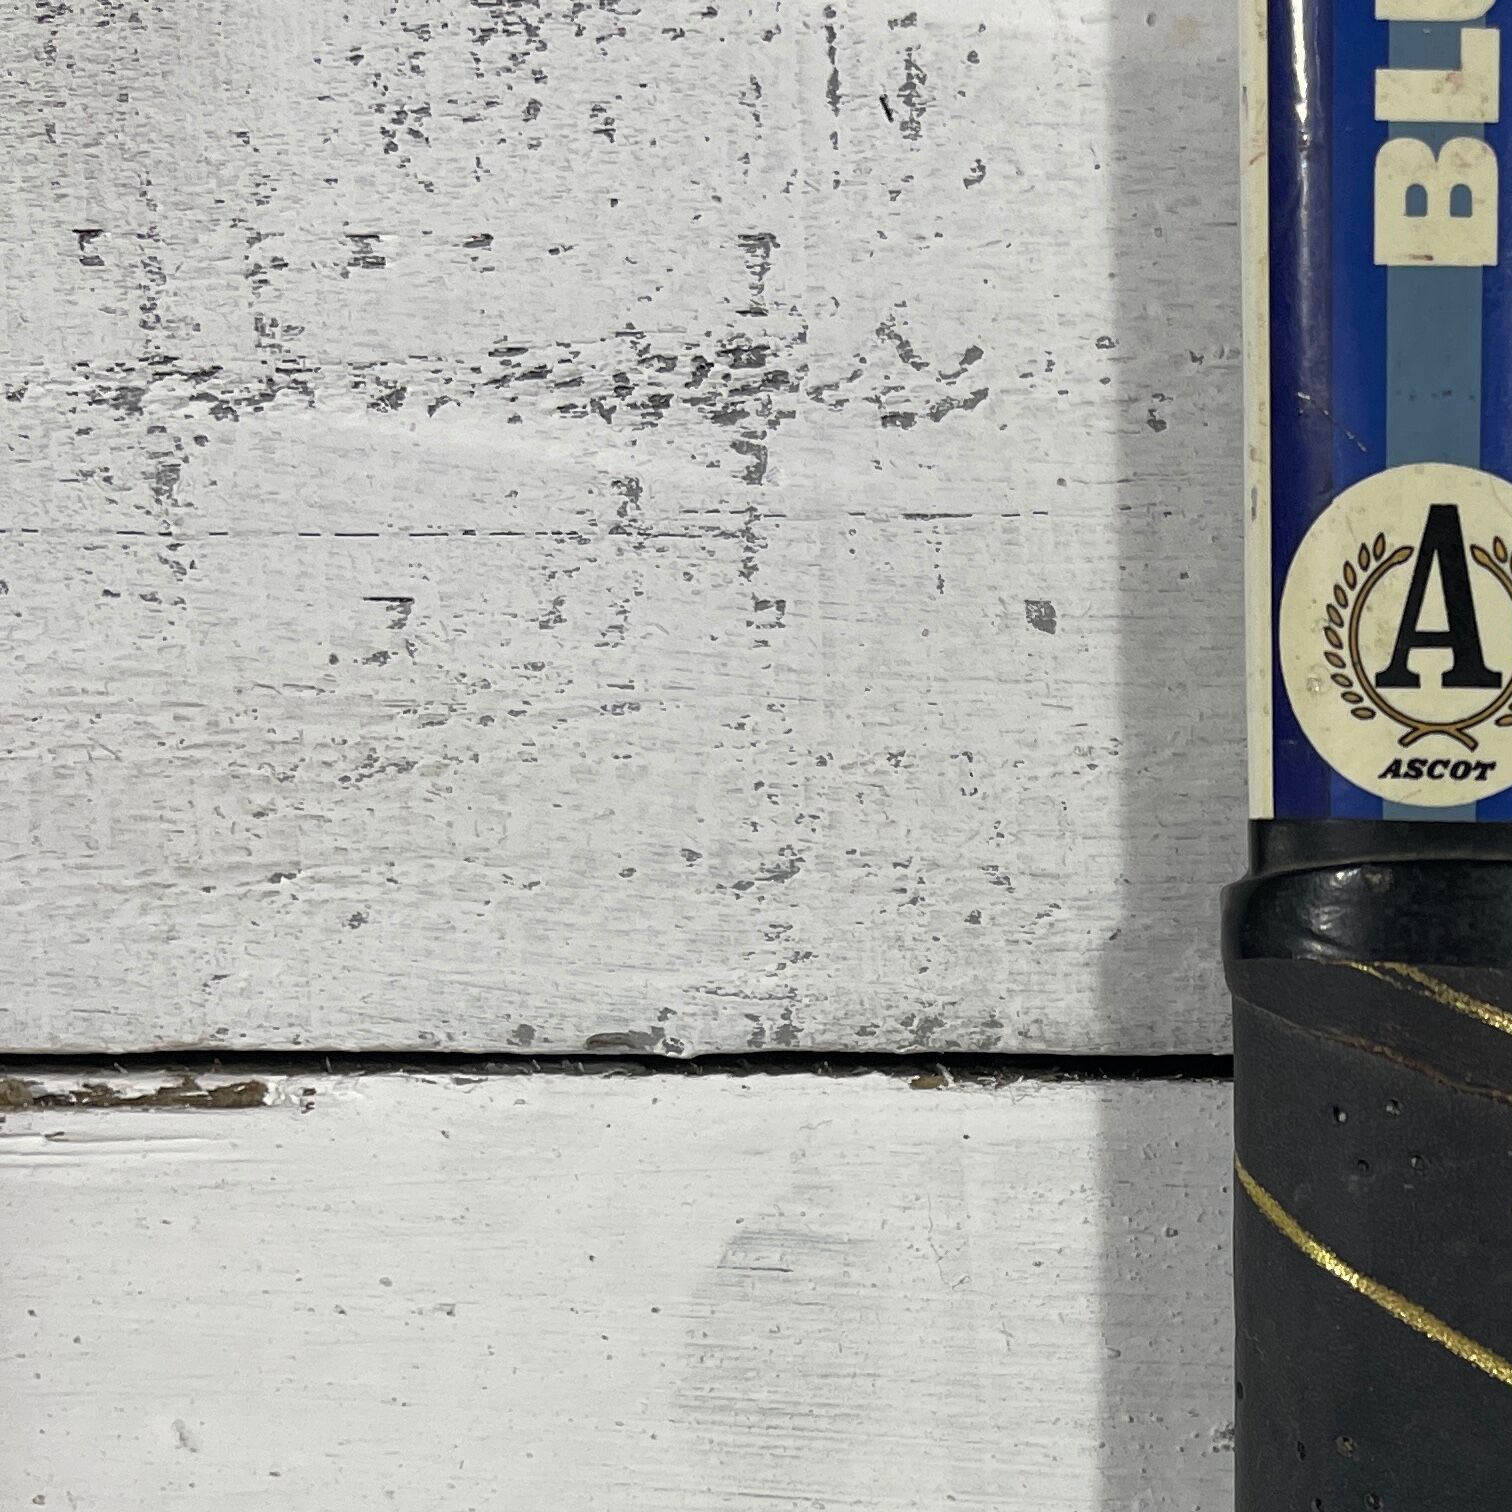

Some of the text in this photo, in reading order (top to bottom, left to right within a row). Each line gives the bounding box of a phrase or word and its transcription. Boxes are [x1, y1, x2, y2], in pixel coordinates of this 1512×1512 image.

[1374, 0, 1499, 266] BL
[1375, 504, 1502, 688] A
[1378, 758, 1496, 781] ASCOT
